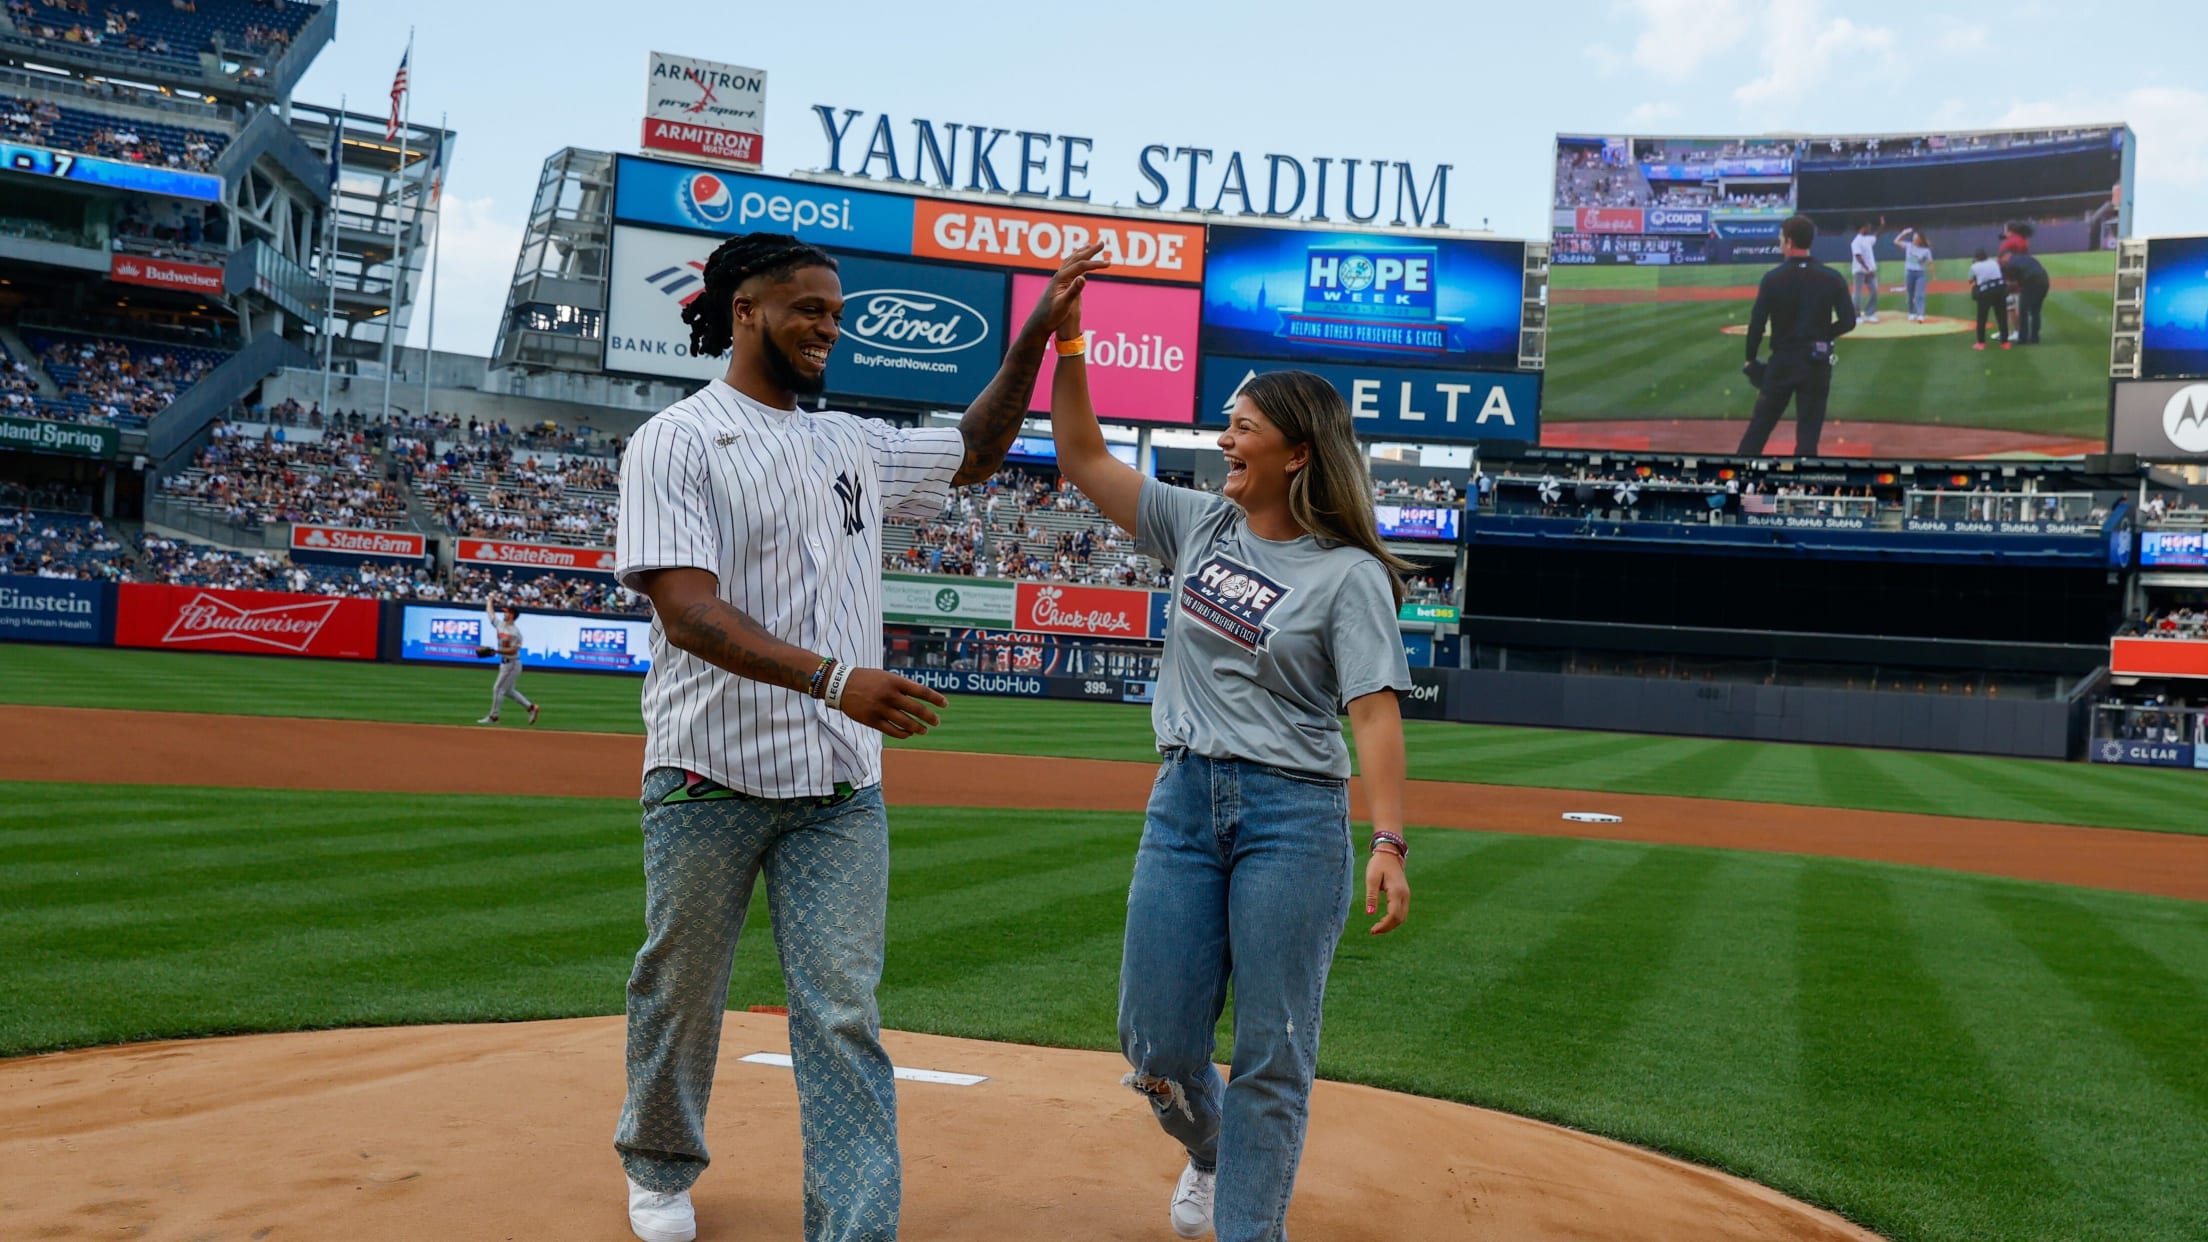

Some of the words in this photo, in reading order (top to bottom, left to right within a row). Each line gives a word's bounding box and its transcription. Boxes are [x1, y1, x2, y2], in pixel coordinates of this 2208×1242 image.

[653, 62, 762, 93] ARMITRON
[655, 124, 753, 151] ARMITRON
[702, 145, 750, 160] WATCHES
[810, 104, 1094, 201] YANKEE
[1134, 144, 1454, 228] STADIUM
[740, 192, 850, 232] pepsi
[933, 213, 1185, 270] GATORADE
[145, 265, 220, 288] Budweiser
[1309, 256, 1428, 292] HOPE
[1323, 291, 1411, 305] WEEK
[855, 295, 962, 345] Ford
[611, 335, 668, 355] BANK
[674, 343, 689, 357] O
[1290, 321, 1321, 338] HELPING
[1324, 323, 1353, 339] OTHERS
[1356, 327, 1402, 344] PERSEVERE
[1416, 330, 1443, 347] EXCEL
[852, 351, 958, 374] BuyFordNow.com
[1351, 378, 1516, 426] ELTA
[43, 423, 105, 453] Spring
[1401, 508, 1436, 520] HOPE
[1747, 515, 1784, 526] StubHub
[1786, 516, 1823, 528] StubHub
[1826, 518, 1863, 529] StubHub
[1907, 520, 1947, 531] StubHub
[1954, 521, 1994, 533] StubHub
[2000, 522, 2039, 533] StubHub
[0, 587, 93, 613] Einstein
[1200, 563, 1278, 611] HOPE
[1032, 594, 1131, 633] Chick-fil-A
[1200, 586, 1253, 619] WEEK
[1416, 607, 1454, 618] bet365
[0, 616, 21, 627] cing
[21, 617, 58, 628] Human
[59, 619, 92, 630] Health
[179, 603, 321, 634] Budweiser
[431, 619, 479, 635] HOPE
[1191, 598, 1211, 618] OTHERS
[1209, 608, 1237, 633] PERSEVERE
[1239, 626, 1256, 644] EXCEL
[580, 629, 625, 644] HOPE
[967, 673, 1041, 694] StubHub
[2130, 747, 2178, 760] CLEAR
